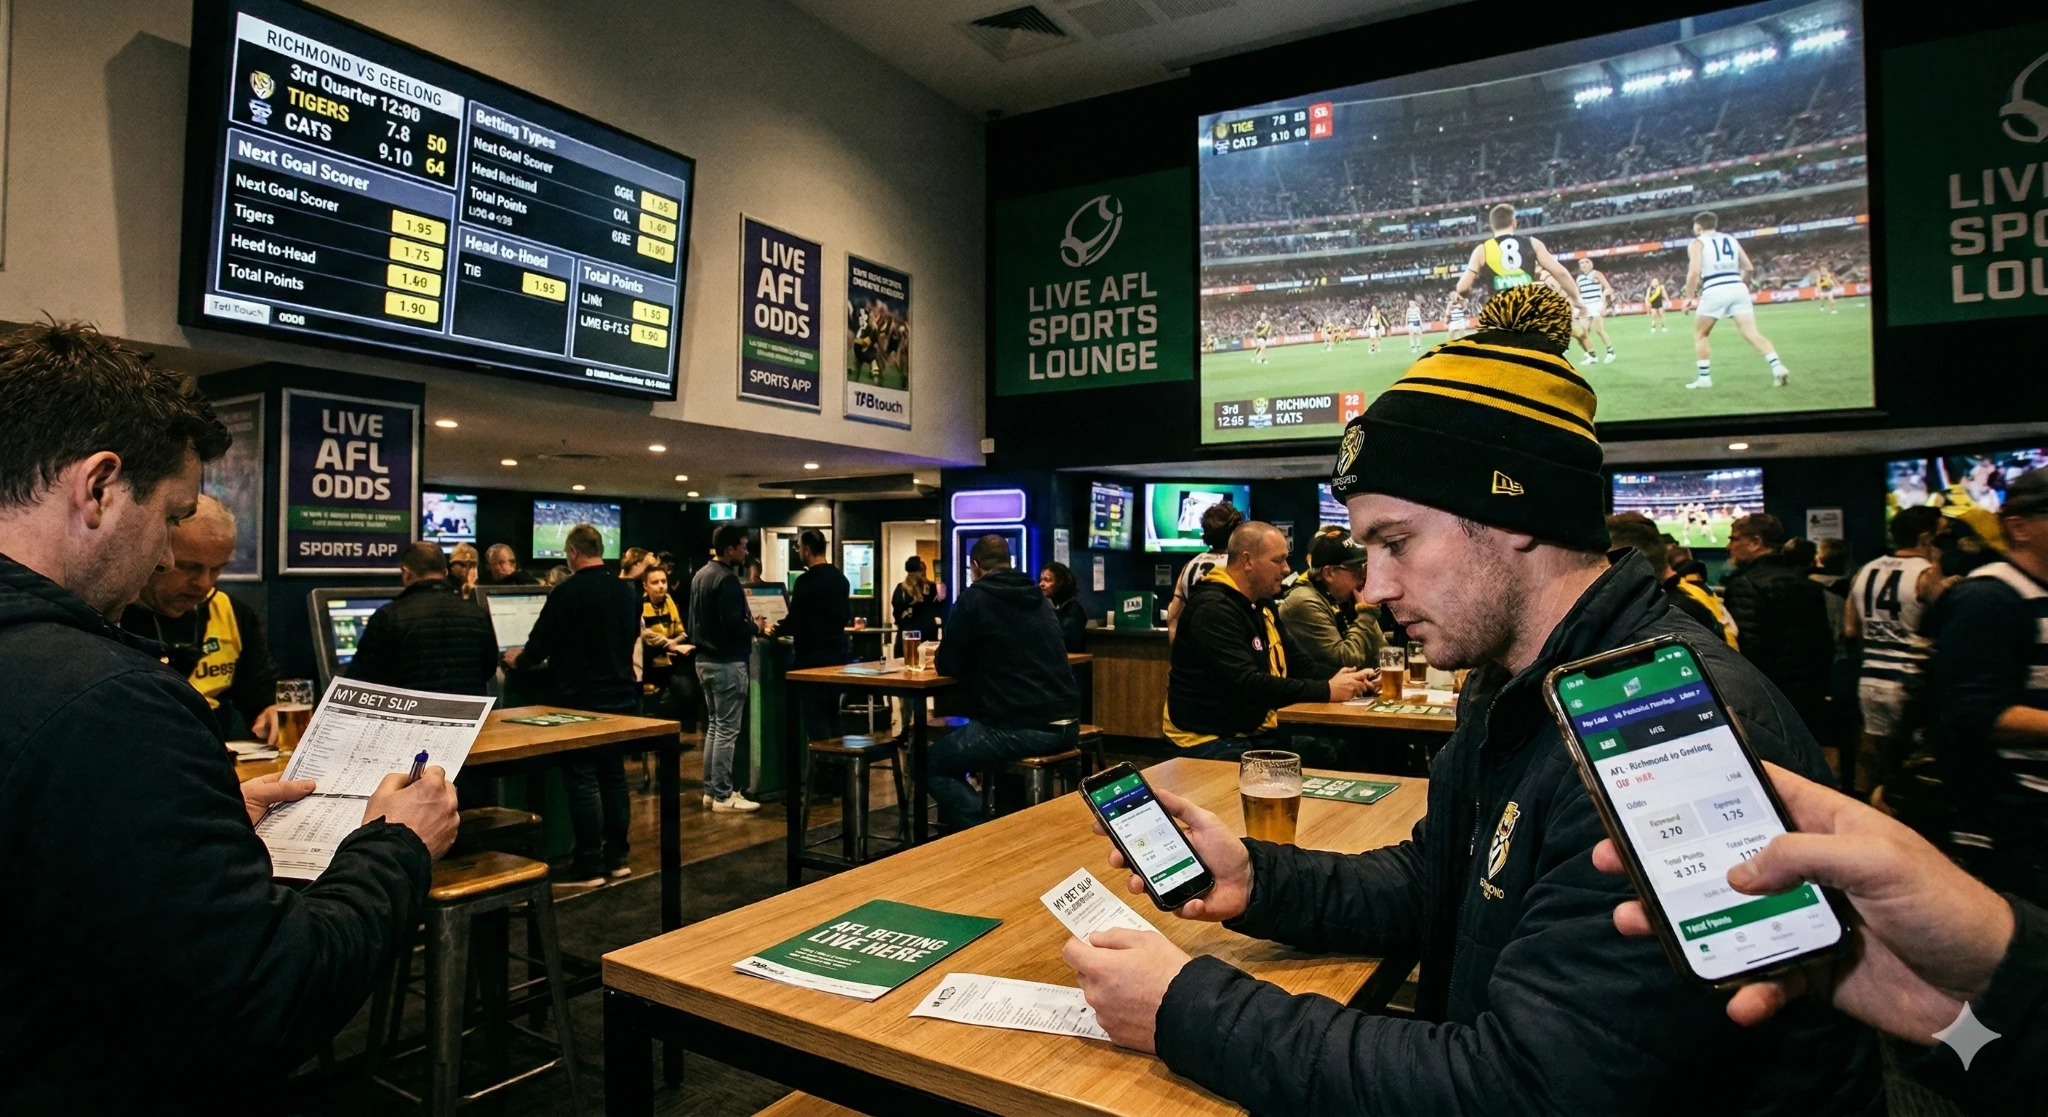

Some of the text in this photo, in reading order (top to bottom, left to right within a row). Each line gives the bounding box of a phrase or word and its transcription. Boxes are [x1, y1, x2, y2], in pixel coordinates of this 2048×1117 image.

[267, 30, 442, 106] RICHMOND VS GEELONG
[290, 64, 317, 87] 3rd
[321, 74, 376, 107] Quarter
[287, 86, 447, 154] TIGERS 7.8 50
[476, 109, 556, 149] Betting Types
[285, 113, 445, 177] CATS 9.10 64
[473, 136, 498, 156] Next
[499, 145, 521, 164] Goal
[523, 153, 554, 174] Scorer
[1232, 136, 1258, 150] CATS
[238, 140, 370, 192] Next Goal Scorer
[471, 162, 497, 181] Head
[236, 173, 432, 235] Next Goal Scorer 1.95
[470, 186, 496, 206] Total
[497, 194, 528, 215] Points
[234, 203, 430, 262] Tigers 1.75
[465, 235, 497, 255] Head
[267, 241, 316, 264] to-Head
[761, 237, 805, 275] LIVE
[1500, 238, 1522, 271] 8
[1711, 237, 1734, 262] 14
[228, 263, 426, 315] Total Points 1.90
[534, 280, 555, 294] 1.95
[584, 266, 644, 294] Total Points
[757, 268, 809, 311] AFL
[1029, 271, 1158, 312] LIVE AFL
[754, 303, 810, 339] ODDS
[1028, 304, 1158, 346] SPORTS
[1029, 339, 1158, 381] LOUNGE
[750, 369, 811, 393] SPORTS APP
[322, 408, 384, 438] LIVE
[1222, 404, 1239, 416] 3rd
[1276, 397, 1332, 411] RICHMOND
[314, 438, 389, 474] AFL
[312, 472, 391, 501] ODDS
[300, 541, 397, 557] SPORTS APP
[1864, 568, 1904, 621] 14
[333, 688, 418, 711] MY BET SLIP
[1629, 753, 1670, 771] Richmond
[1722, 809, 1744, 822] 1.75
[1053, 896, 1067, 911] MY
[1064, 886, 1080, 903] BET
[807, 929, 869, 950] LIVE
[859, 942, 932, 963] HERE
[829, 921, 949, 951] AFL BETTING
